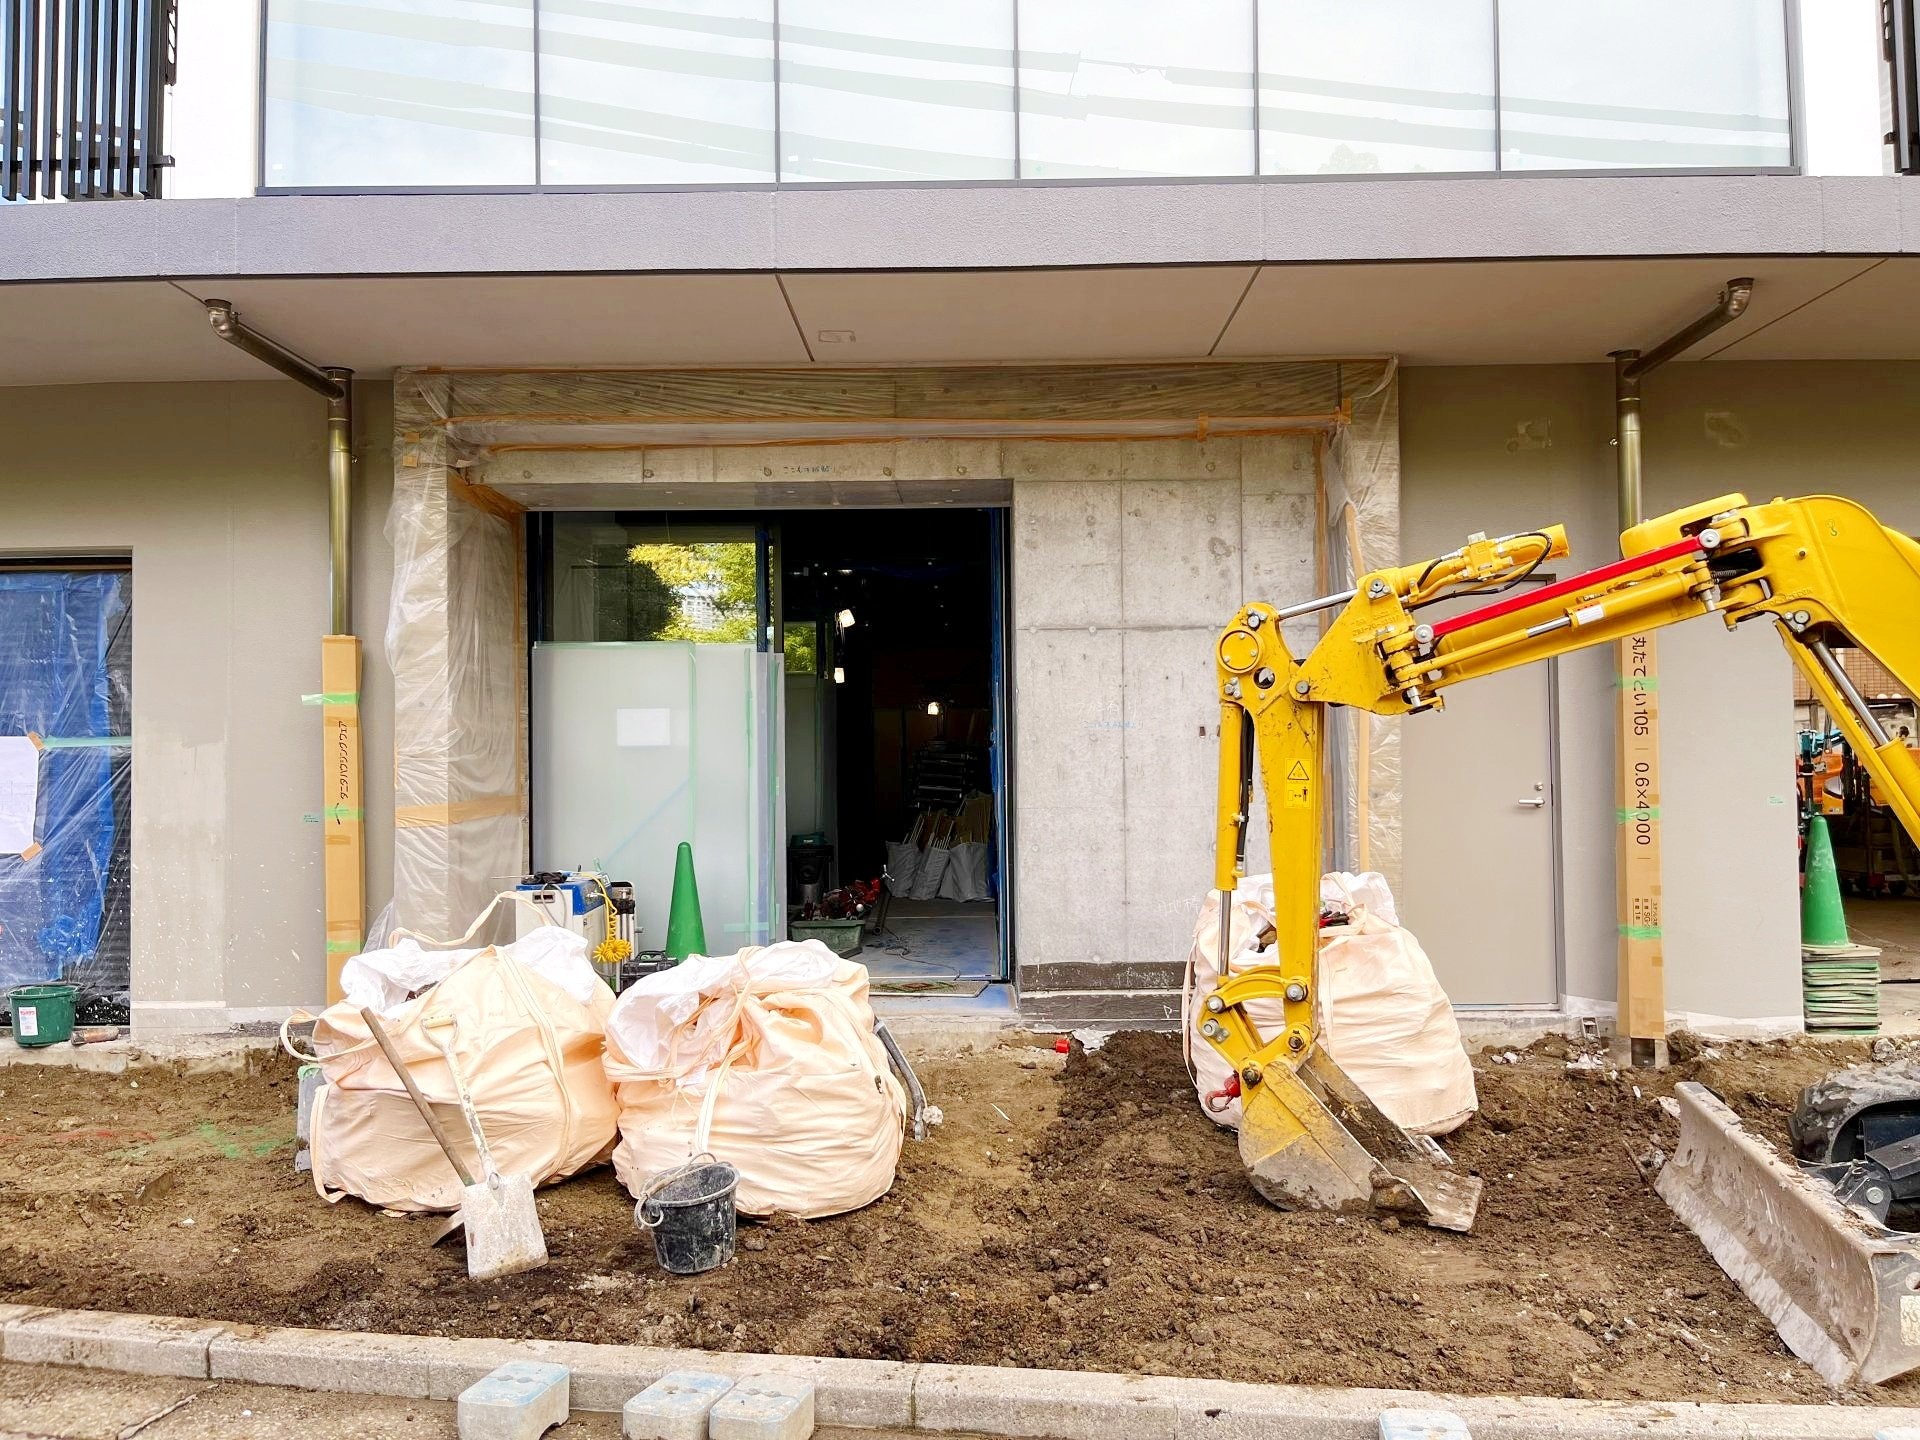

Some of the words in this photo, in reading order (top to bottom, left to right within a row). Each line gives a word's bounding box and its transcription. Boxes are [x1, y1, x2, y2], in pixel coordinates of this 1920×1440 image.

[338, 720, 349, 800] タニタハウジングウェア
